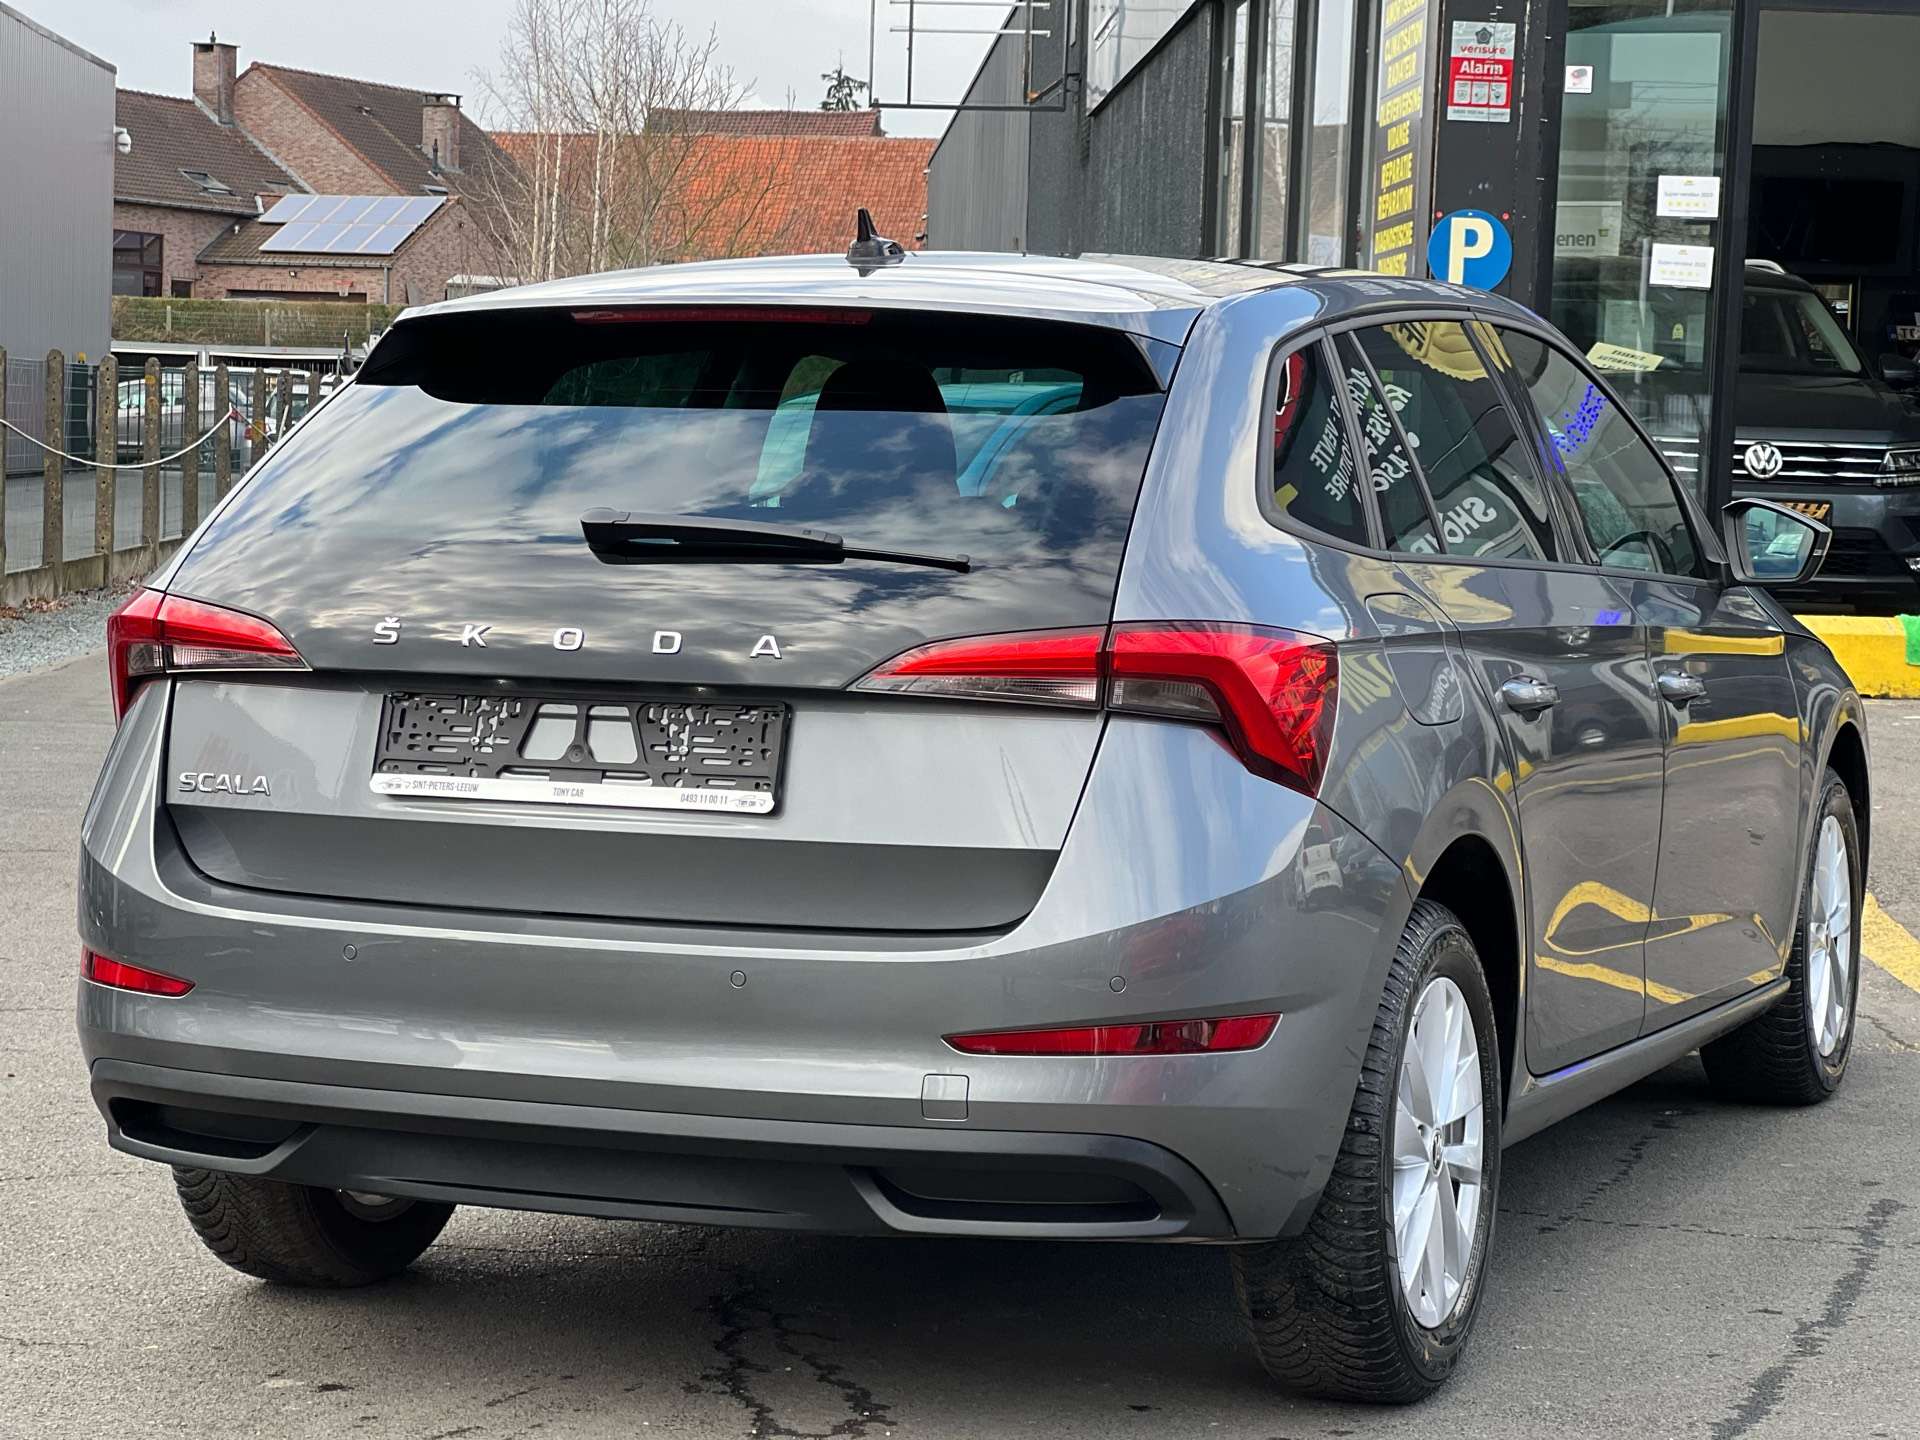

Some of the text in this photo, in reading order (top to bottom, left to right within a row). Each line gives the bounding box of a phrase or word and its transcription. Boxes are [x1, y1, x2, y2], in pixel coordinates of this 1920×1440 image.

[1460, 44, 1506, 55] verisure
[1460, 59, 1503, 75] Alarm
[1447, 216, 1494, 285] P
[372, 616, 783, 659] ŠKODA
[178, 771, 271, 796] SCALA
[412, 779, 480, 793] SINT-PIETERS-LEEUW
[553, 787, 585, 798] TONY CAR
[680, 793, 698, 802] 0493
[700, 794, 708, 804] 11
[708, 795, 718, 804] 00
[720, 796, 728, 804] 11
